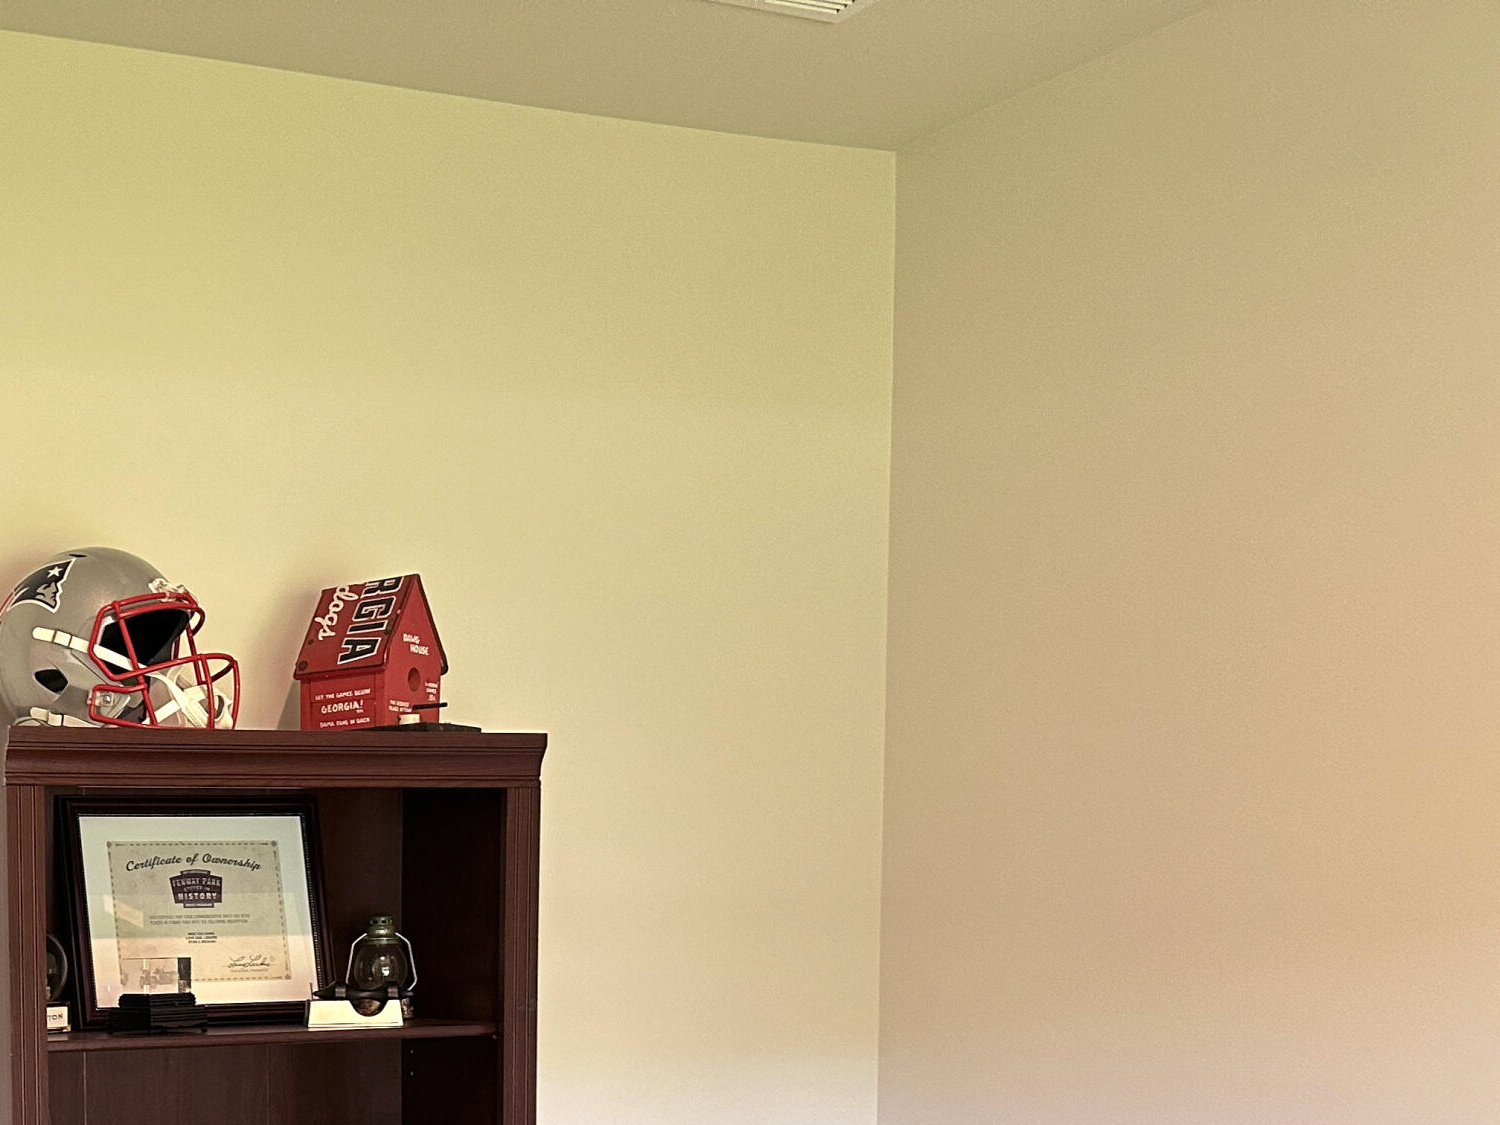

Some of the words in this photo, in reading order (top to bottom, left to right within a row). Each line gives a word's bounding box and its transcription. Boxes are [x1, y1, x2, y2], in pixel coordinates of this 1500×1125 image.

[410, 643, 429, 656] HOUSE
[321, 699, 364, 714] GEORGIA!
[126, 855, 182, 871] Certificate
[185, 852, 199, 866] of
[202, 853, 261, 871] Ownership
[202, 877, 221, 887] PARK
[178, 892, 218, 901] HISTORY
